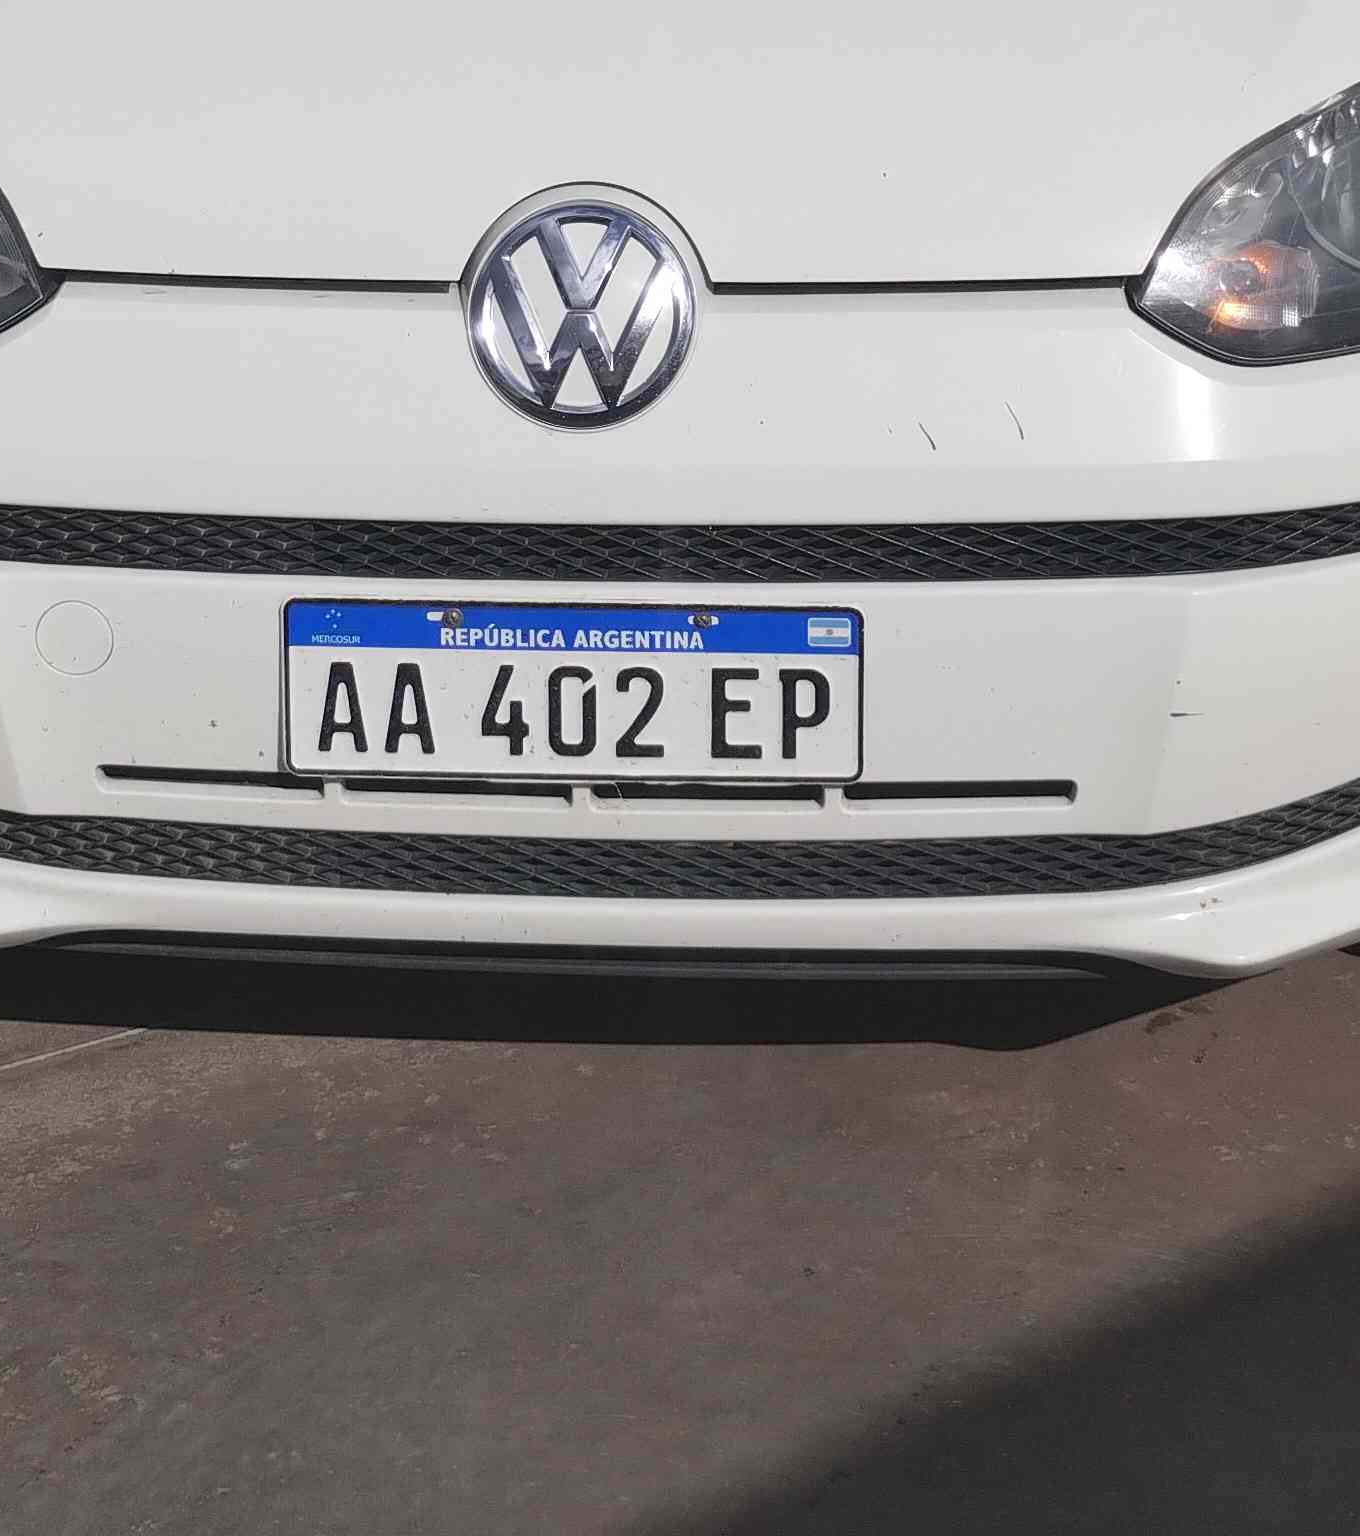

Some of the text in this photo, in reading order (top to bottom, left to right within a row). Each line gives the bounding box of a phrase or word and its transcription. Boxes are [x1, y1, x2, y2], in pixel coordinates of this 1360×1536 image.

[312, 634, 361, 644] MERCOSUR
[440, 624, 705, 649] REPÚBLICA ARGENTINA
[317, 662, 830, 759] AA 402 EP
